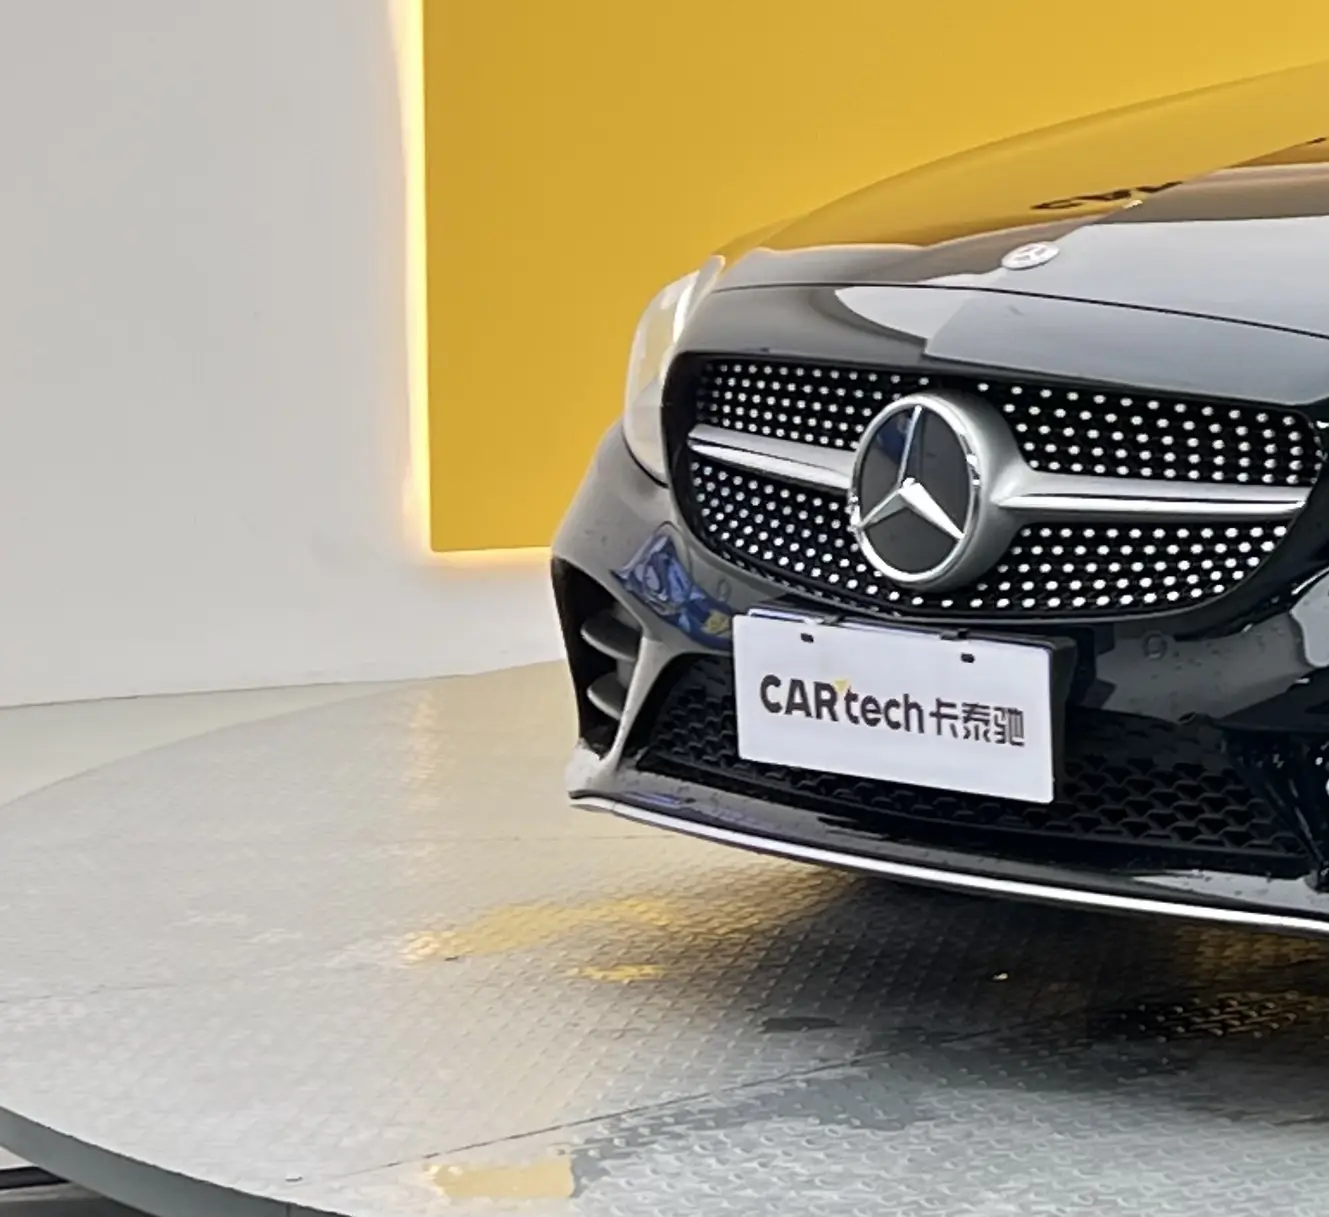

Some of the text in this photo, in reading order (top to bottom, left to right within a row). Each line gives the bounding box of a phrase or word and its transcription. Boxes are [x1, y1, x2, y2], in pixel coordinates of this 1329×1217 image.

[759, 674, 1026, 748] CARtech 卡泰驰
